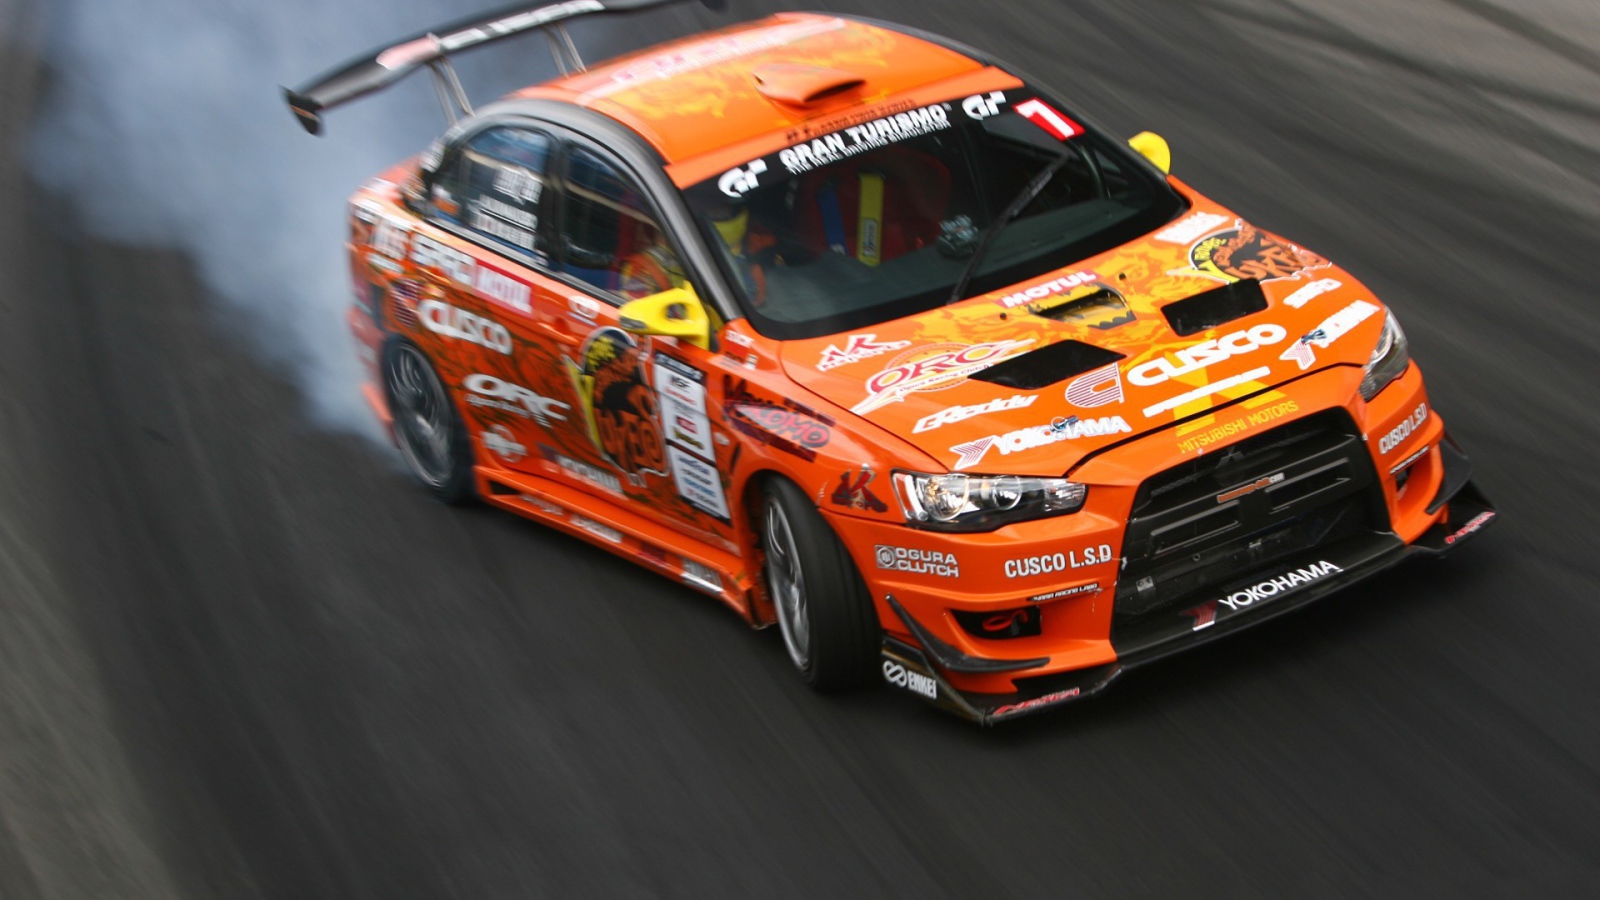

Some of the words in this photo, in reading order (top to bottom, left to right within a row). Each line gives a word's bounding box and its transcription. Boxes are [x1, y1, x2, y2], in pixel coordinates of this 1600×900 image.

[779, 133, 846, 166] GRAN
[845, 104, 947, 144] TURISMO
[1002, 270, 1097, 308] MOTUL
[417, 299, 512, 355] CUSCO
[867, 343, 1006, 395] ORC
[1127, 323, 1287, 386] CUSCO
[463, 373, 571, 422] ORC
[1177, 420, 1247, 454] MITSUBISHI
[1251, 400, 1299, 427] MOTORS
[1379, 419, 1411, 455] CUSCO
[895, 547, 958, 565] OGURA
[895, 559, 960, 578] CLUTCH
[1005, 553, 1066, 578] CUSCO
[1070, 544, 1112, 569] L.S.D
[1055, 587, 1079, 598] RACING
[1218, 560, 1344, 611] YOKOHAMA
[907, 671, 937, 699] ENKEI
